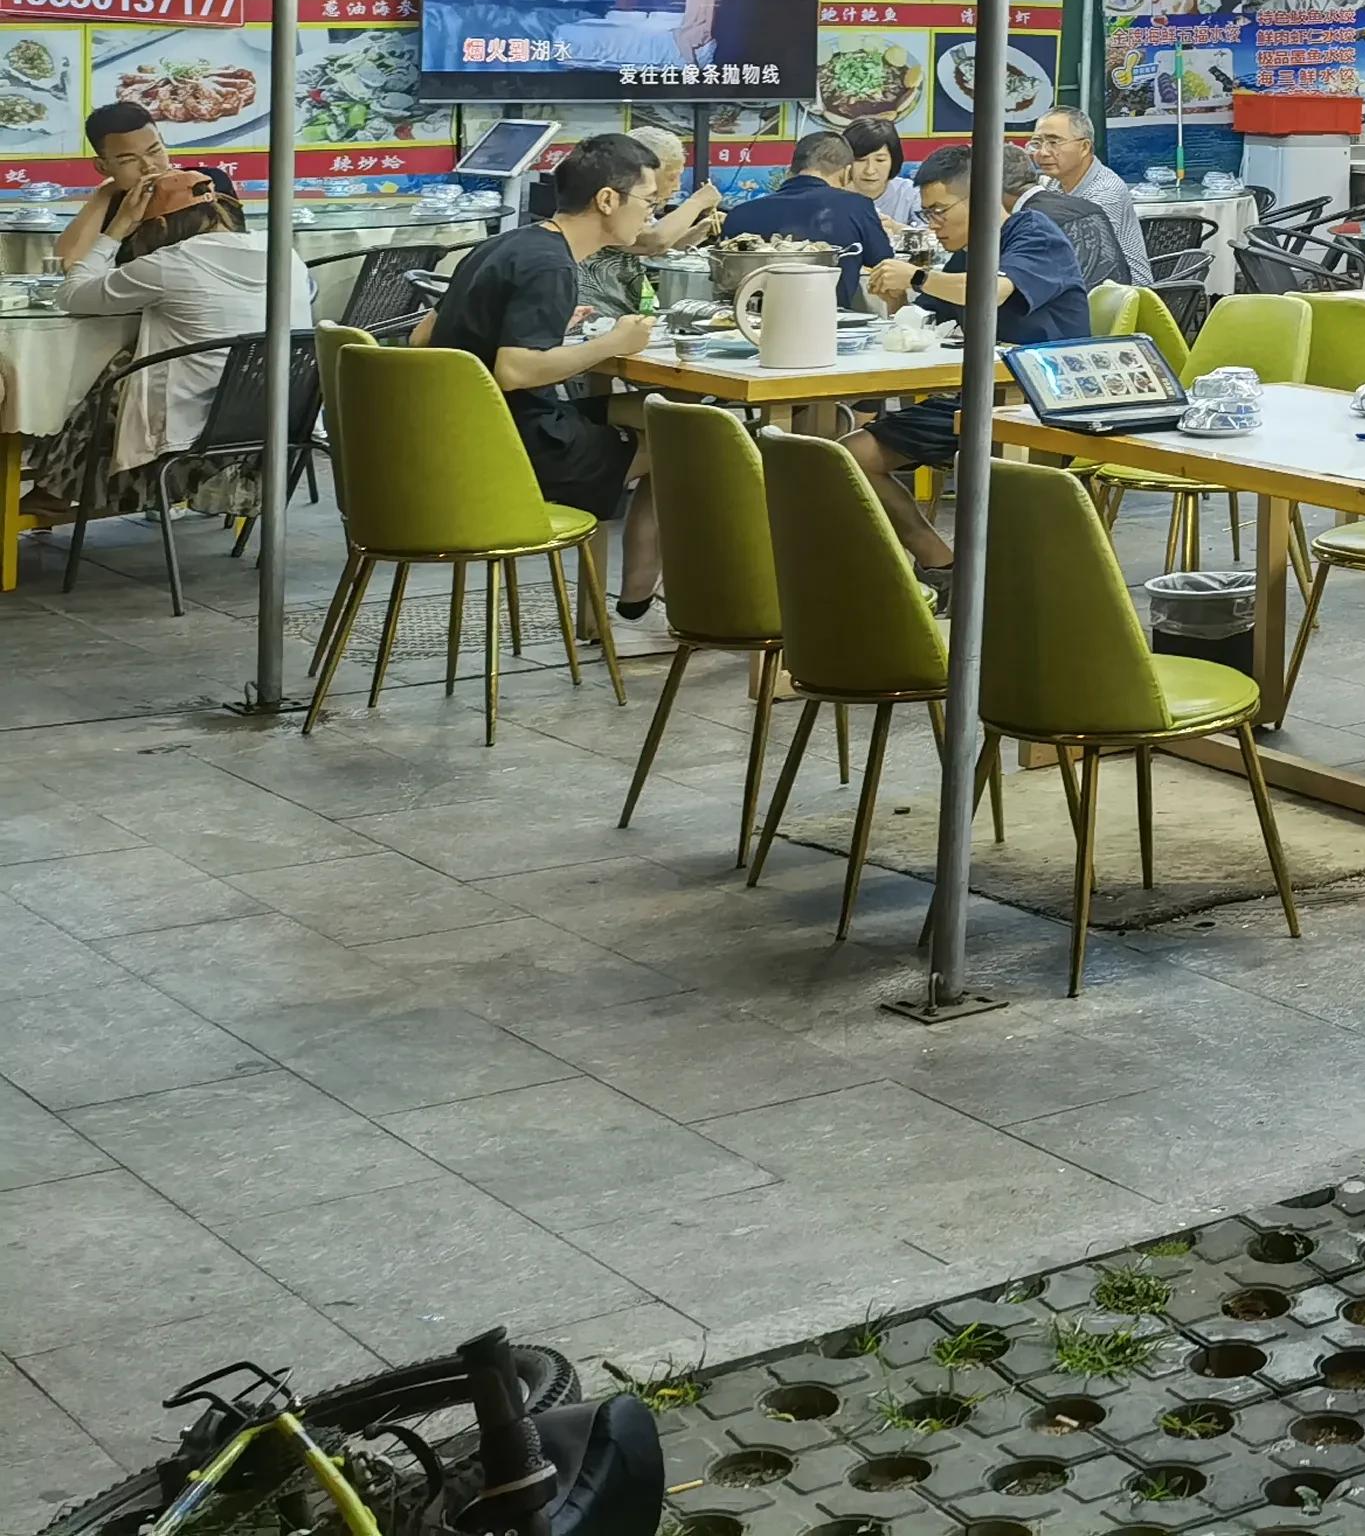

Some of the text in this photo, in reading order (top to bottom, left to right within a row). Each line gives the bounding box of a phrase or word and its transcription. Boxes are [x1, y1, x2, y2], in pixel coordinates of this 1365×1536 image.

[618, 64, 781, 86] 爱往往像条抛物线
